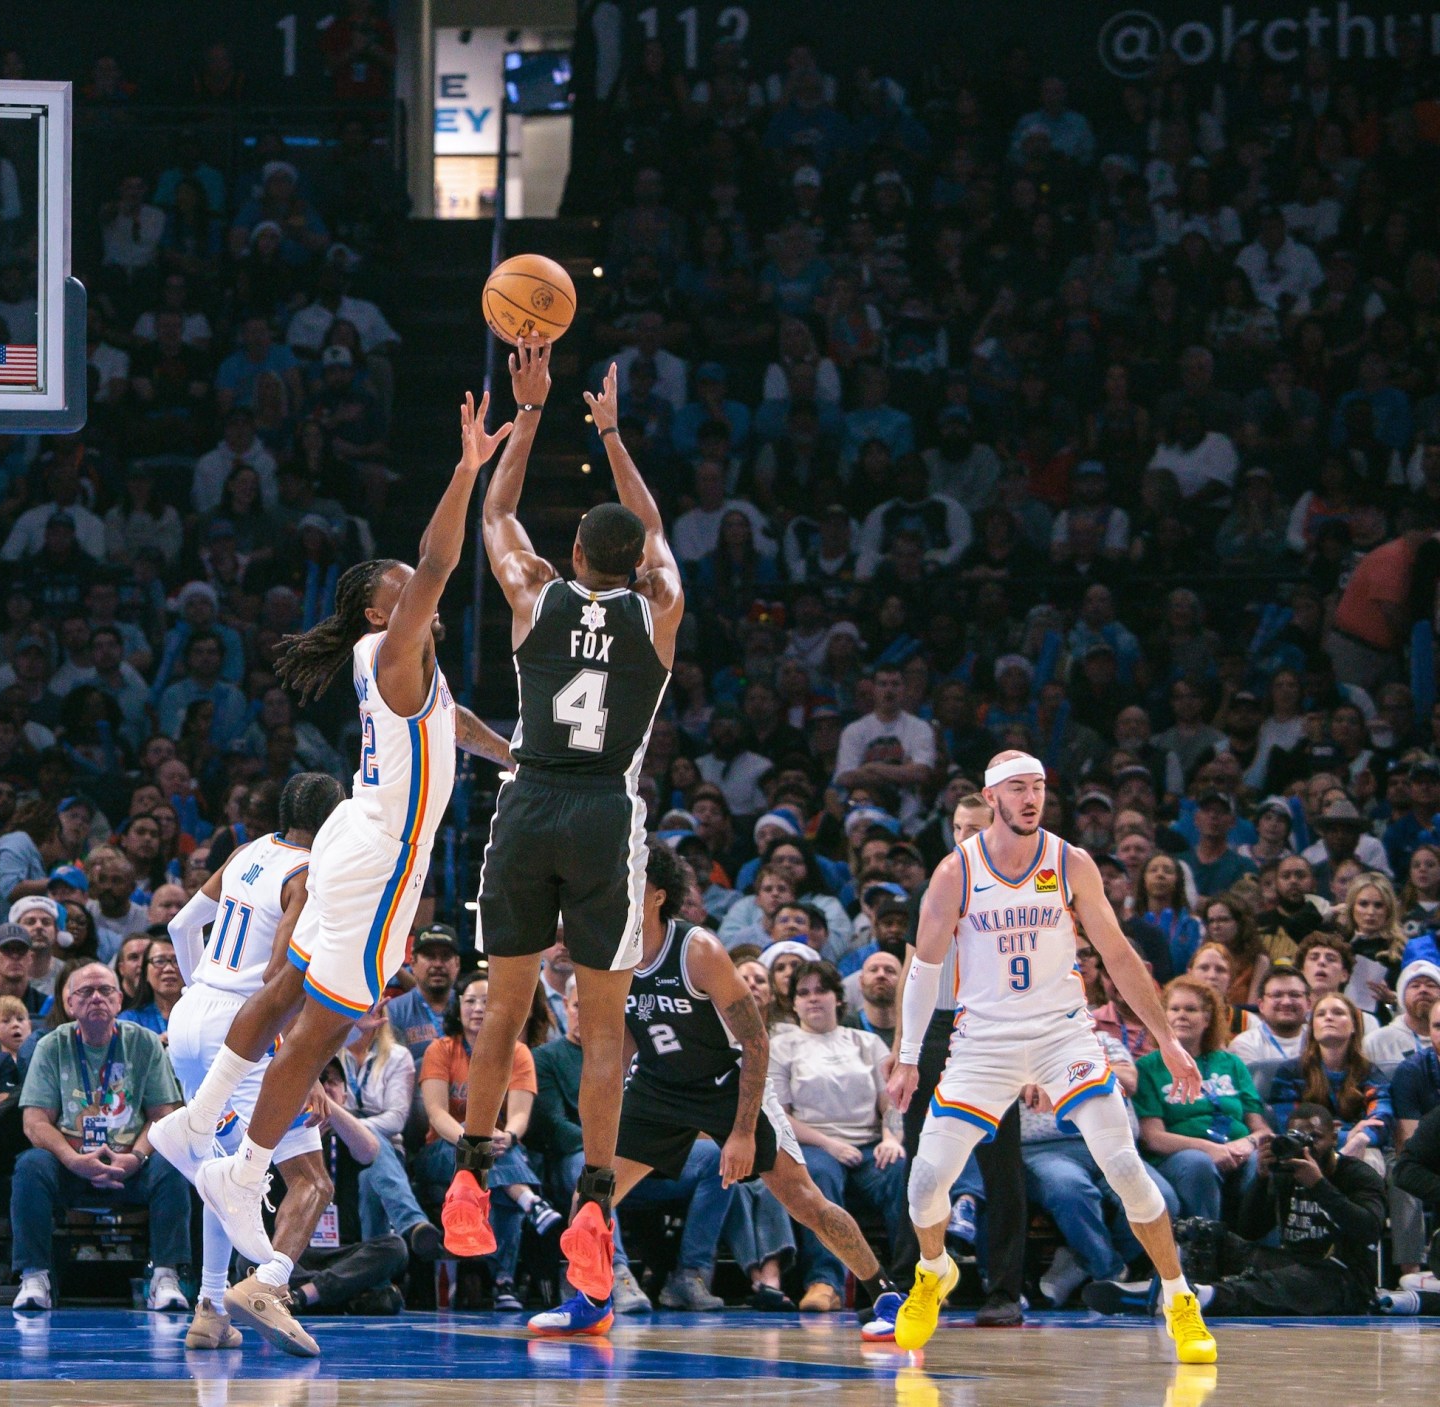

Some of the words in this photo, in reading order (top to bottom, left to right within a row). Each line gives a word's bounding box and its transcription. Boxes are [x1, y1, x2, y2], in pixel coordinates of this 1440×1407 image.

[570, 629, 614, 663] FOX
[552, 667, 609, 752] 4
[241, 863, 264, 886] JOE
[211, 896, 254, 972] 11
[967, 904, 1064, 934] OKLAHOMA
[996, 930, 1039, 954] CITY
[1009, 955, 1042, 993] 9
[625, 994, 693, 1022] PURS
[646, 1022, 684, 1056] 2
